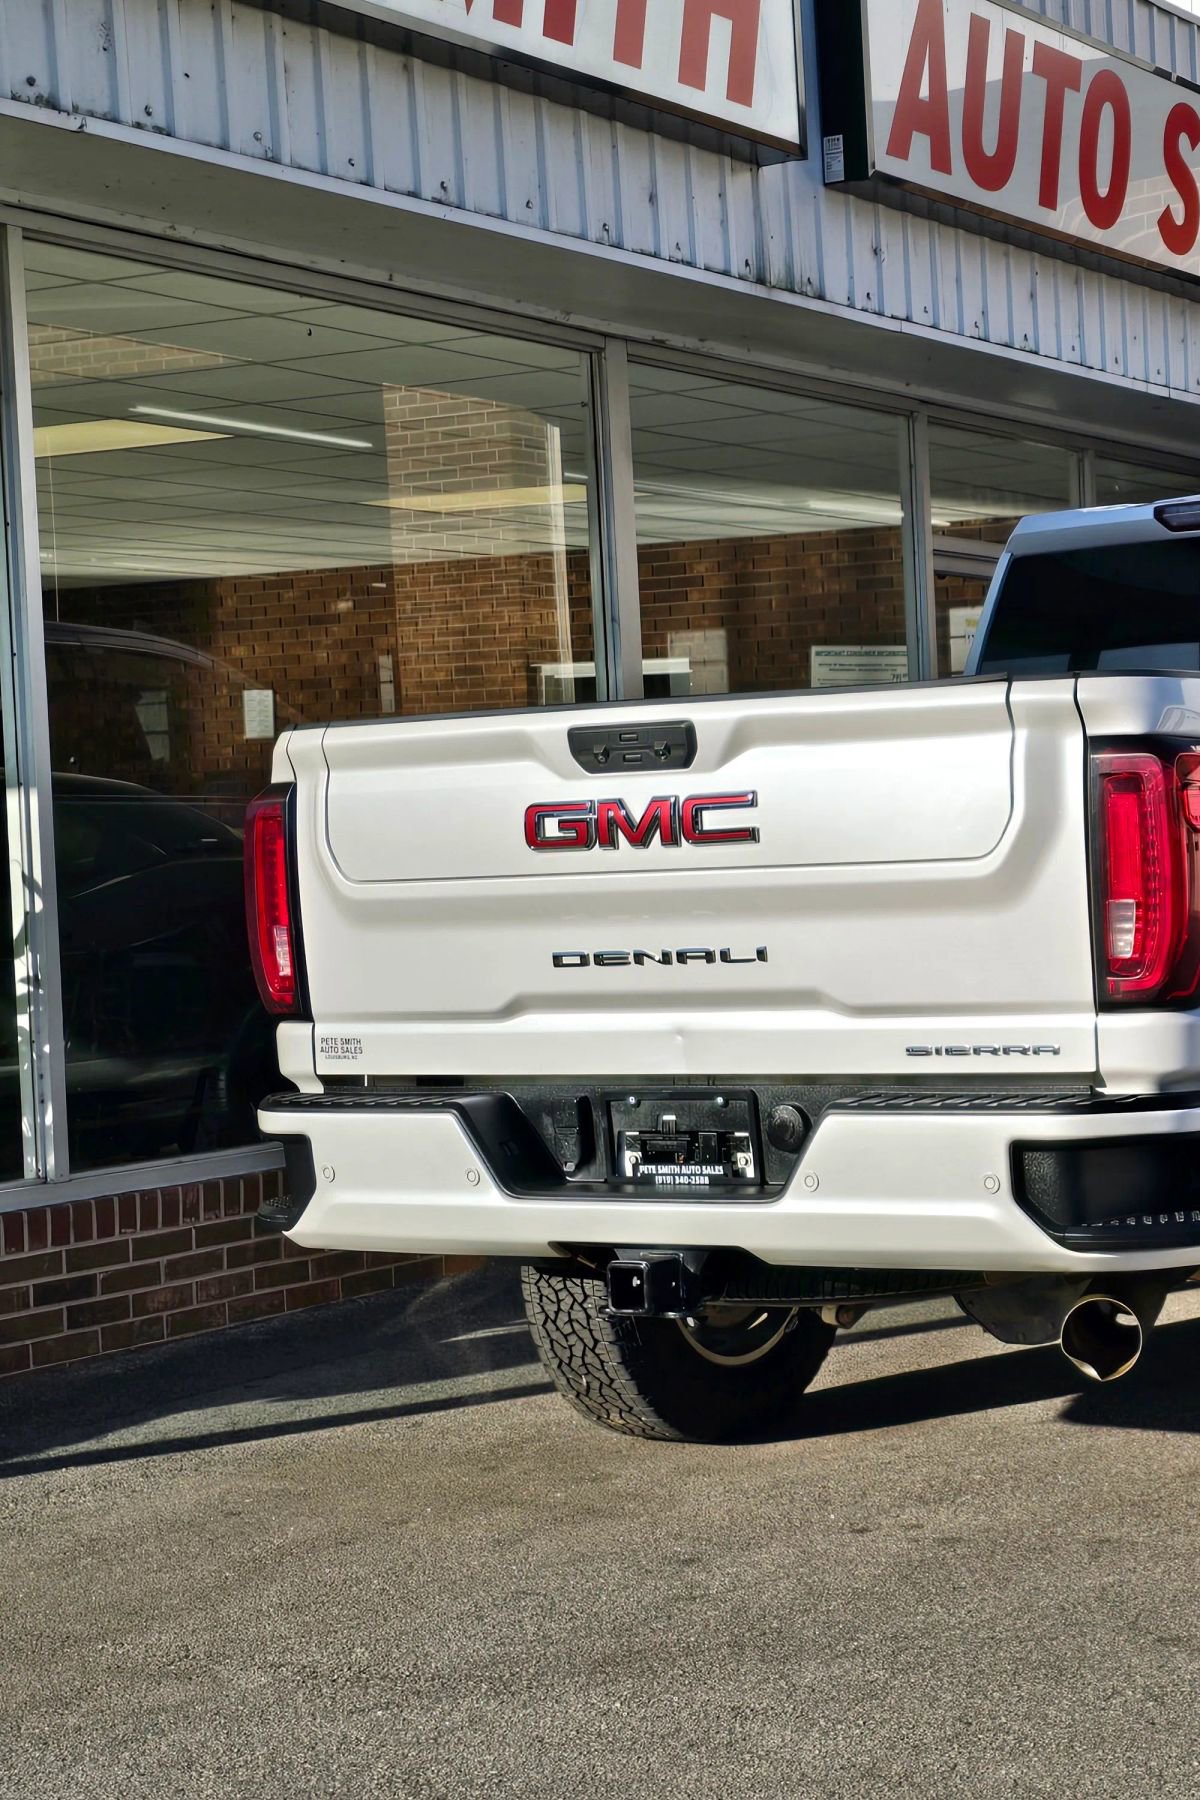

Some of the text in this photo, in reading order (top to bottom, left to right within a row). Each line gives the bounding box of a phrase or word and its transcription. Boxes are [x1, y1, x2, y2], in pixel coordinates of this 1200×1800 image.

[885, 0, 1132, 231] AUTO
[524, 790, 761, 853] GMC
[552, 946, 769, 968] DENALI
[320, 1037, 362, 1046] PETE SMITH
[320, 1046, 363, 1054] AUTO SALES
[905, 1043, 1061, 1056] SIERRA
[639, 1165, 724, 1174] PETE SMITH AUTO SALES
